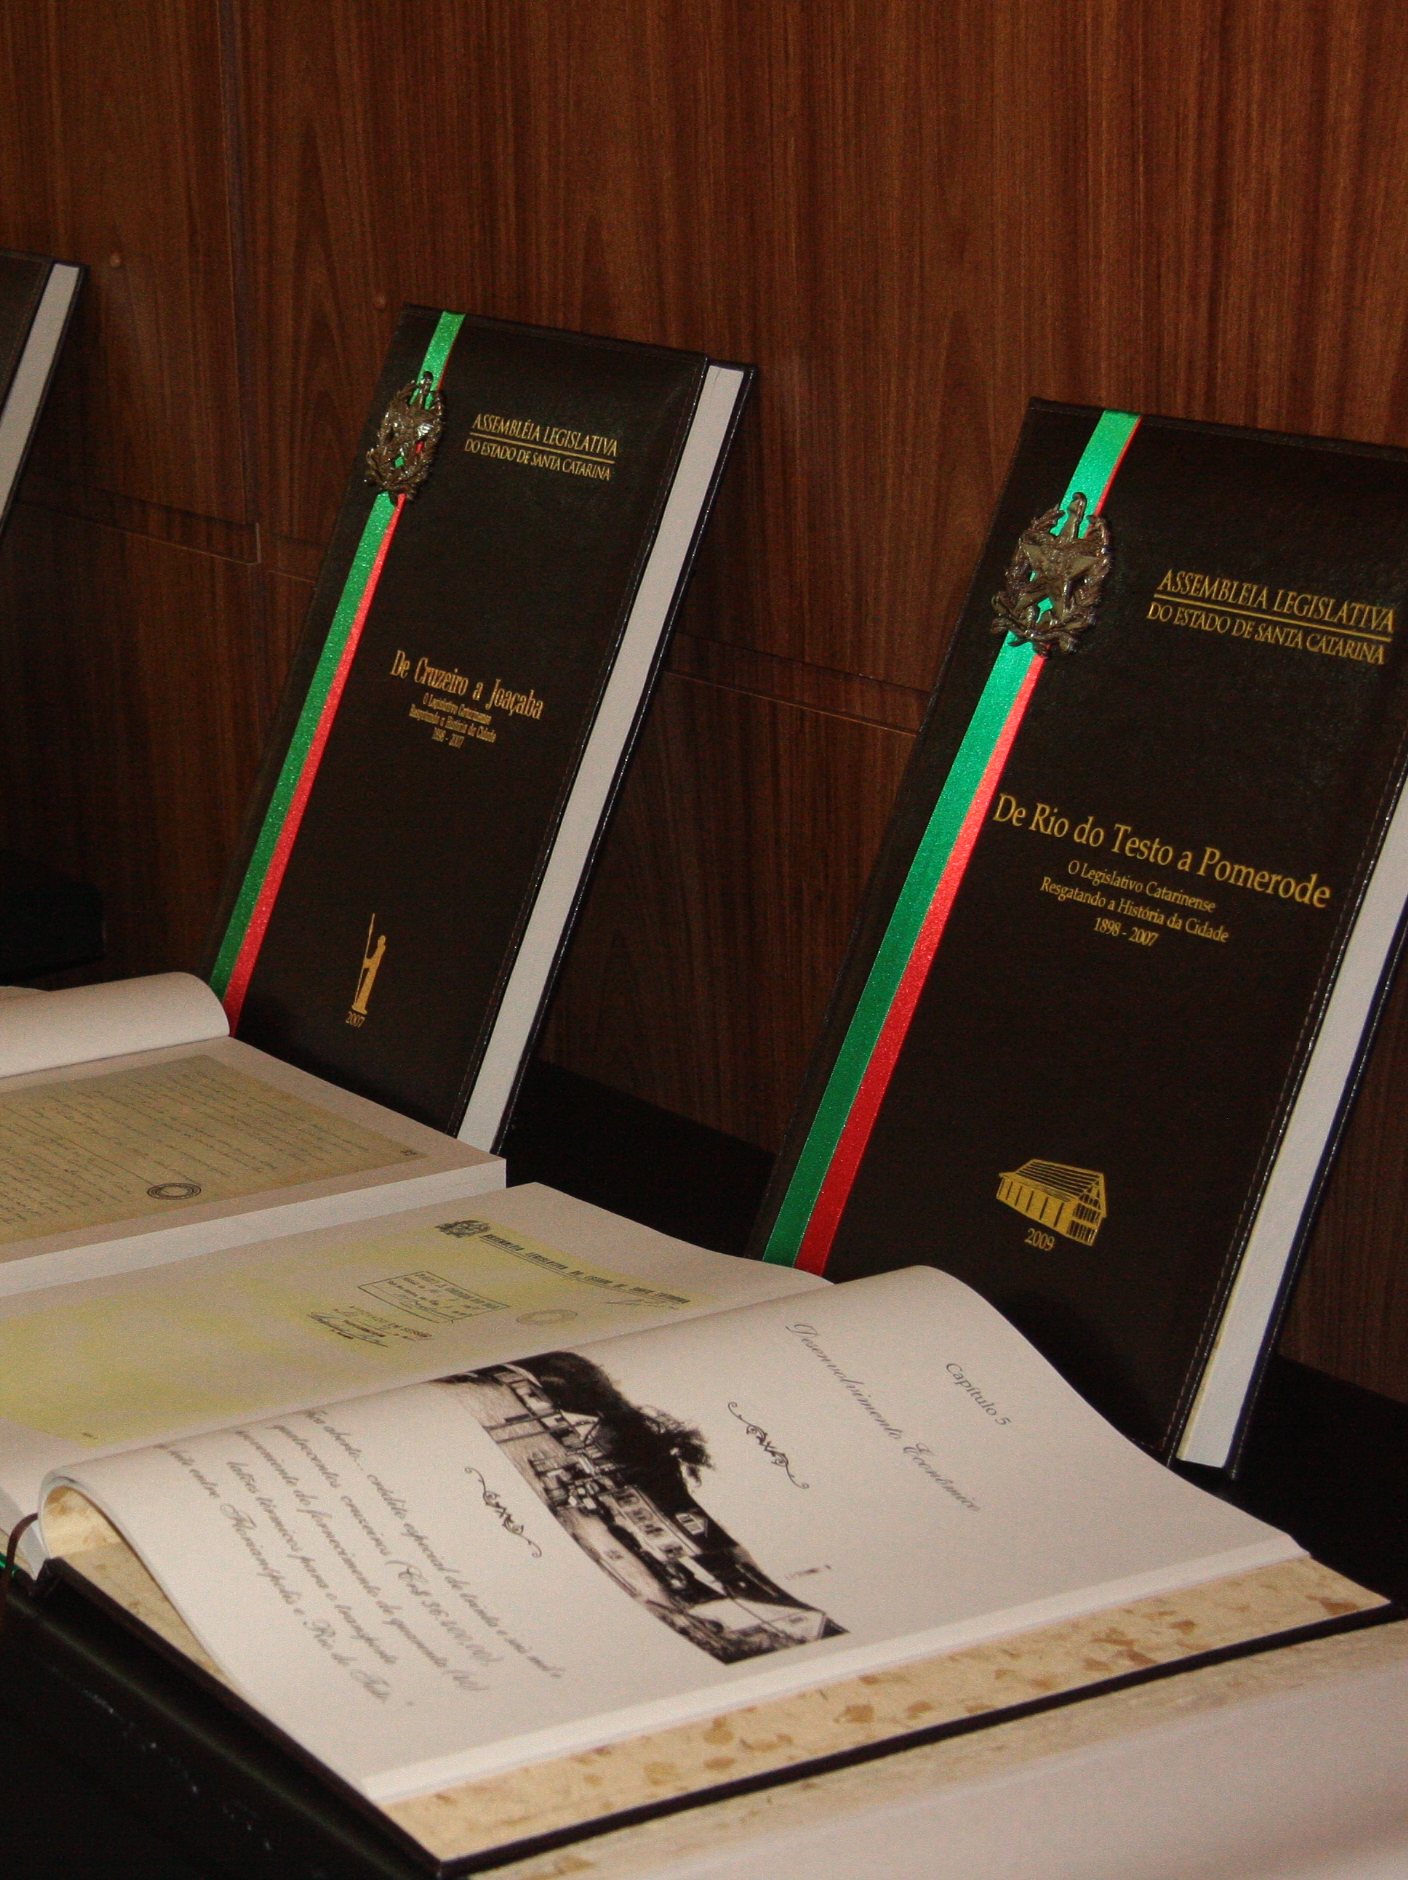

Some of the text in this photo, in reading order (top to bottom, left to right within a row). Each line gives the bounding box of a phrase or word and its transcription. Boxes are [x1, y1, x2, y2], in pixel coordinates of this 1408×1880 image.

[464, 439, 611, 481] DO ESTADO DE SANTA CATARINA
[472, 413, 618, 457] ASSEMBLÉIA LEGISLATIVA
[1146, 601, 1385, 665] DO ESTADO DE SANTA CATARINA
[1157, 569, 1395, 634] ASSEMBLEIA LEGISLATIVA
[390, 650, 544, 720] De Cruzeiro a Joaçaba
[993, 793, 1332, 909] De Rio do Testo a Pomerode
[1040, 877, 1230, 943] Resgatando a História da Cidade
[1068, 860, 1217, 914] O Legislativo Catarinense
[1093, 916, 1122, 937] 1898
[1128, 927, 1160, 947] 2007
[1024, 1227, 1055, 1252] 2009
[786, 1323, 980, 1512] Desenvolvimento Econômico
[946, 1362, 1011, 1427] Capítulo 5
[291, 1488, 319, 1506] do
[339, 1495, 392, 1557] cruzeiros
[365, 1473, 409, 1520] crédito
[403, 1522, 451, 1573] especial
[285, 1553, 330, 1590] para
[295, 1507, 382, 1598] fornecimento
